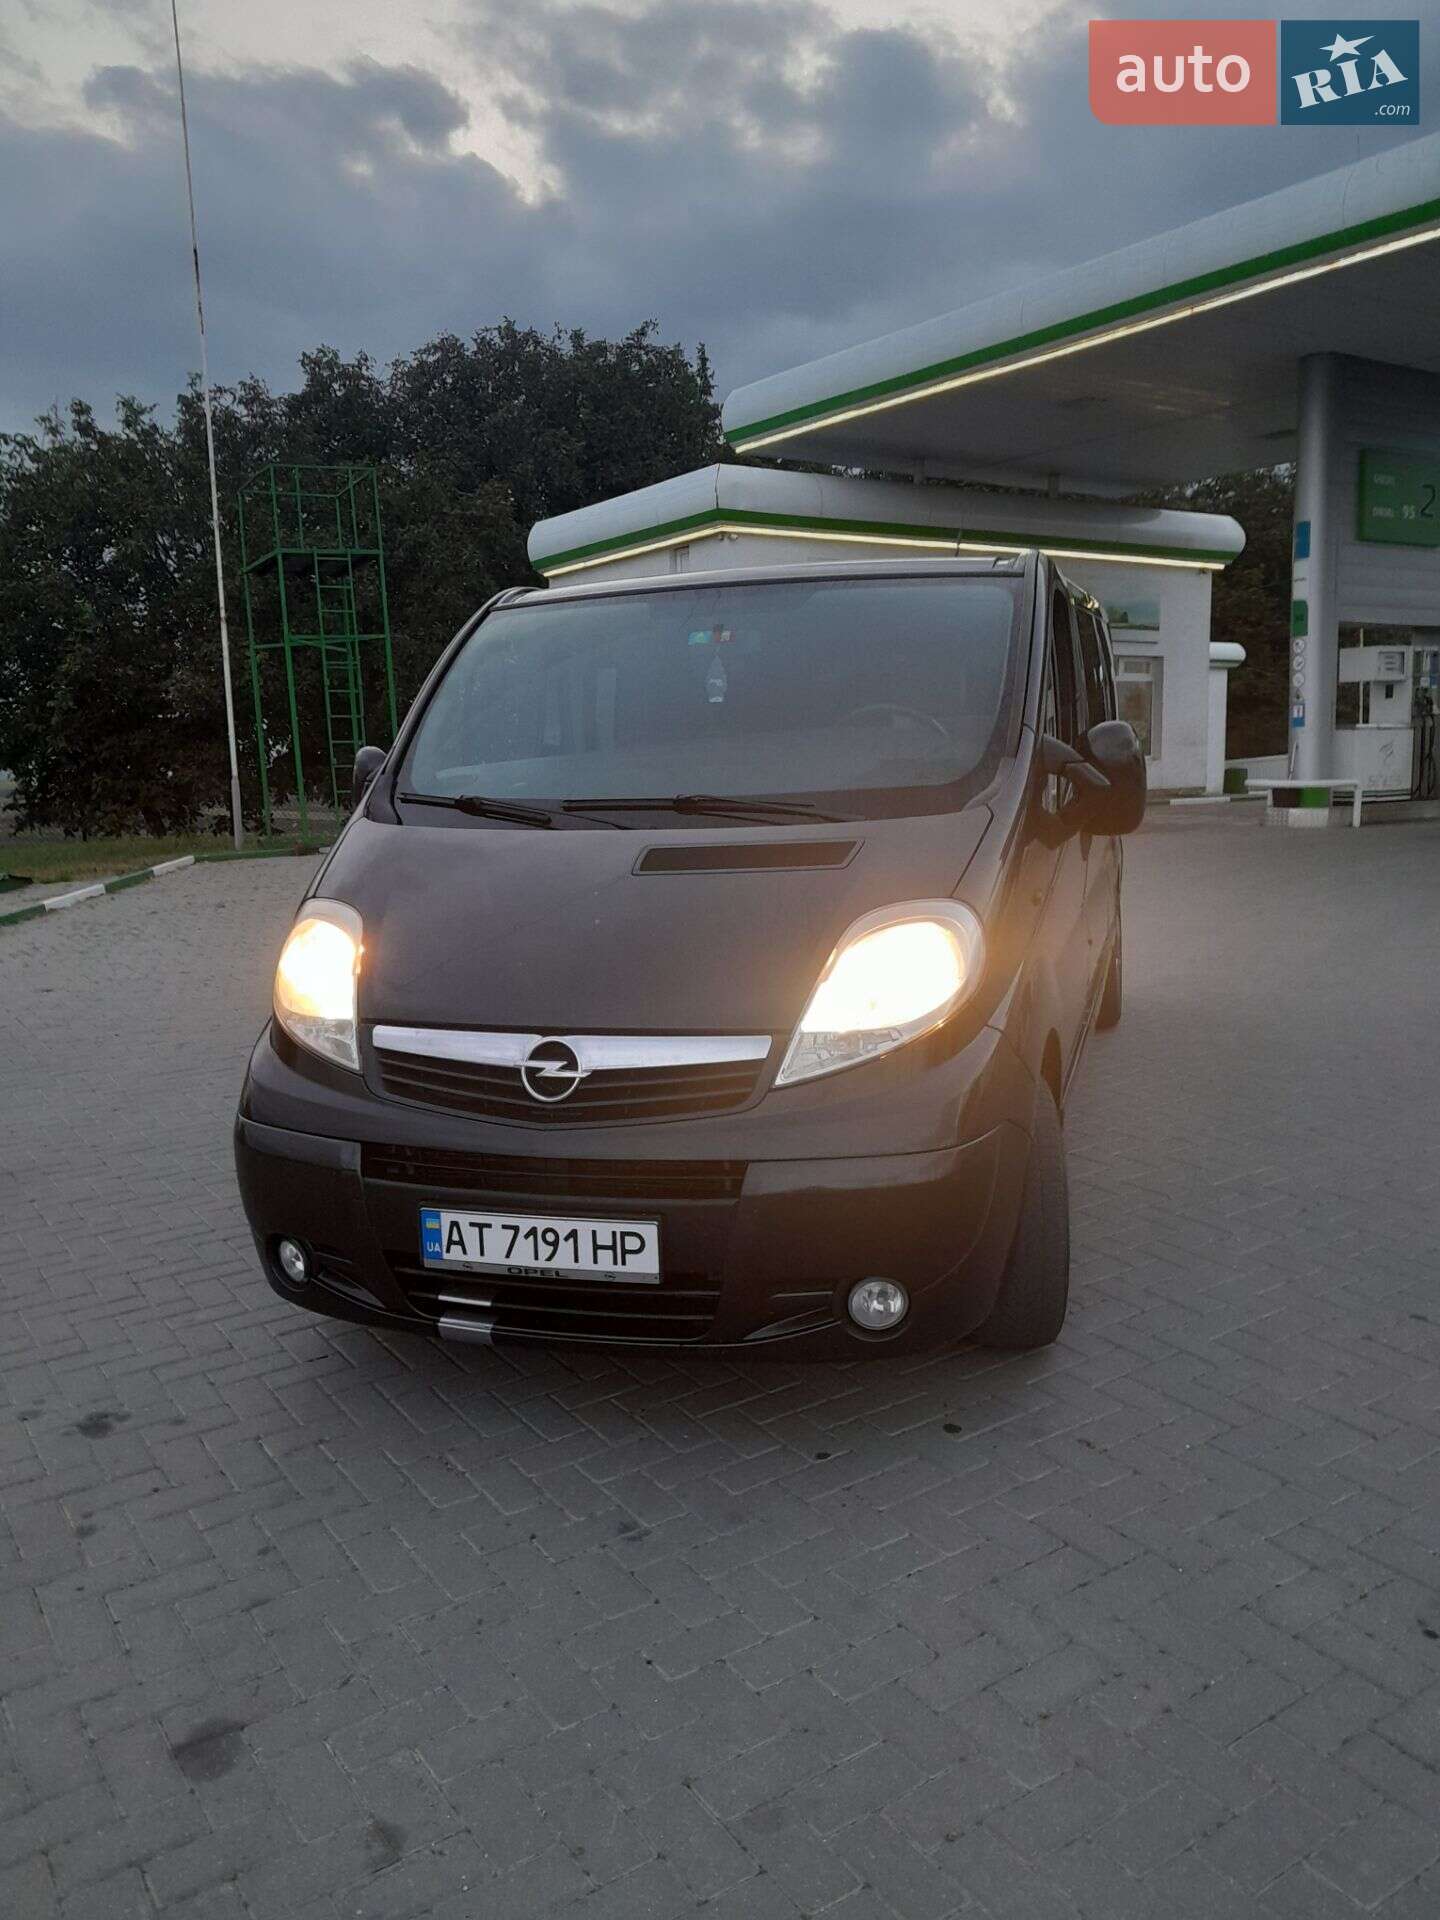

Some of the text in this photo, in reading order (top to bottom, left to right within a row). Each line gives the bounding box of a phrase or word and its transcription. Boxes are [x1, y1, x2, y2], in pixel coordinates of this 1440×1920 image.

[426, 1241, 442, 1253] UA
[446, 1220, 646, 1266] AT 7191 HP
[507, 1266, 569, 1279] OPEL
